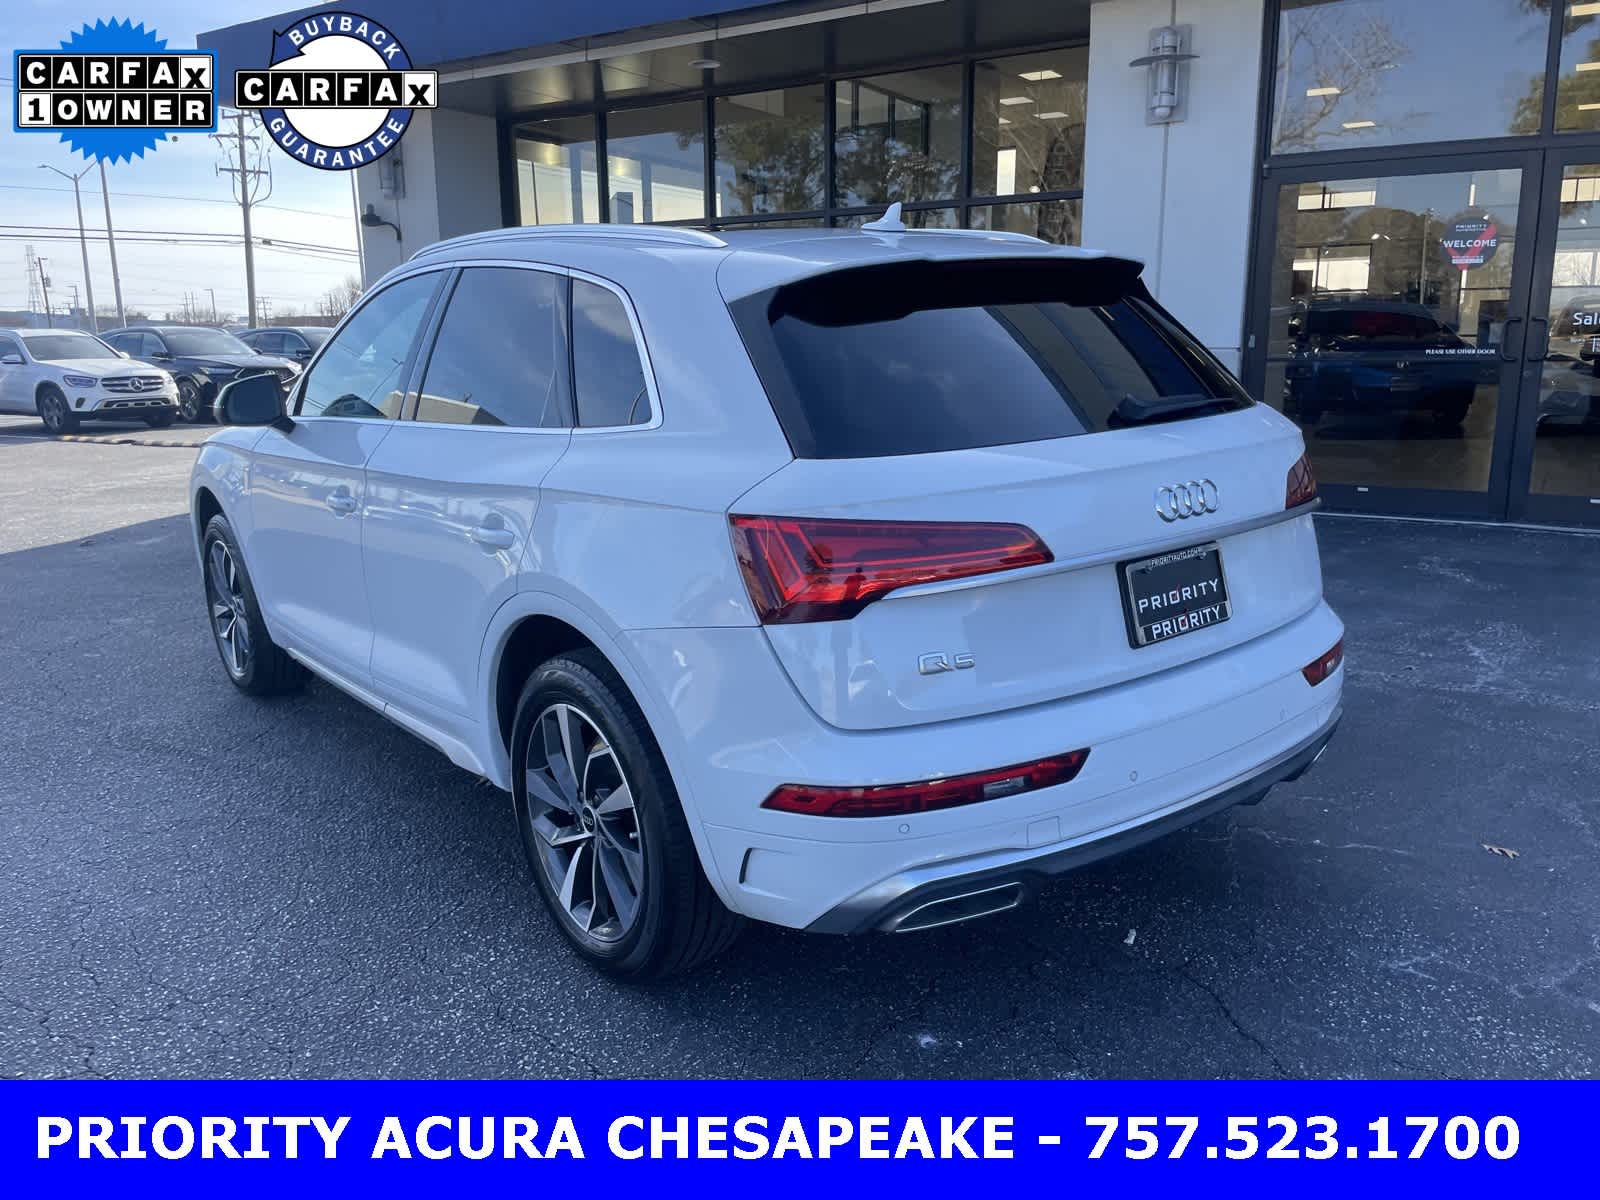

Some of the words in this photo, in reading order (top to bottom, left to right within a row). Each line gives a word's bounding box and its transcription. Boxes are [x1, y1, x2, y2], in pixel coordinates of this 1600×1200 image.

[1443, 239, 1497, 248] WELCOME
[1572, 312, 1600, 326] Sal
[1138, 578, 1218, 613] PRIORITY
[1152, 606, 1221, 639] PRIORITY
[917, 651, 976, 676] Q5
